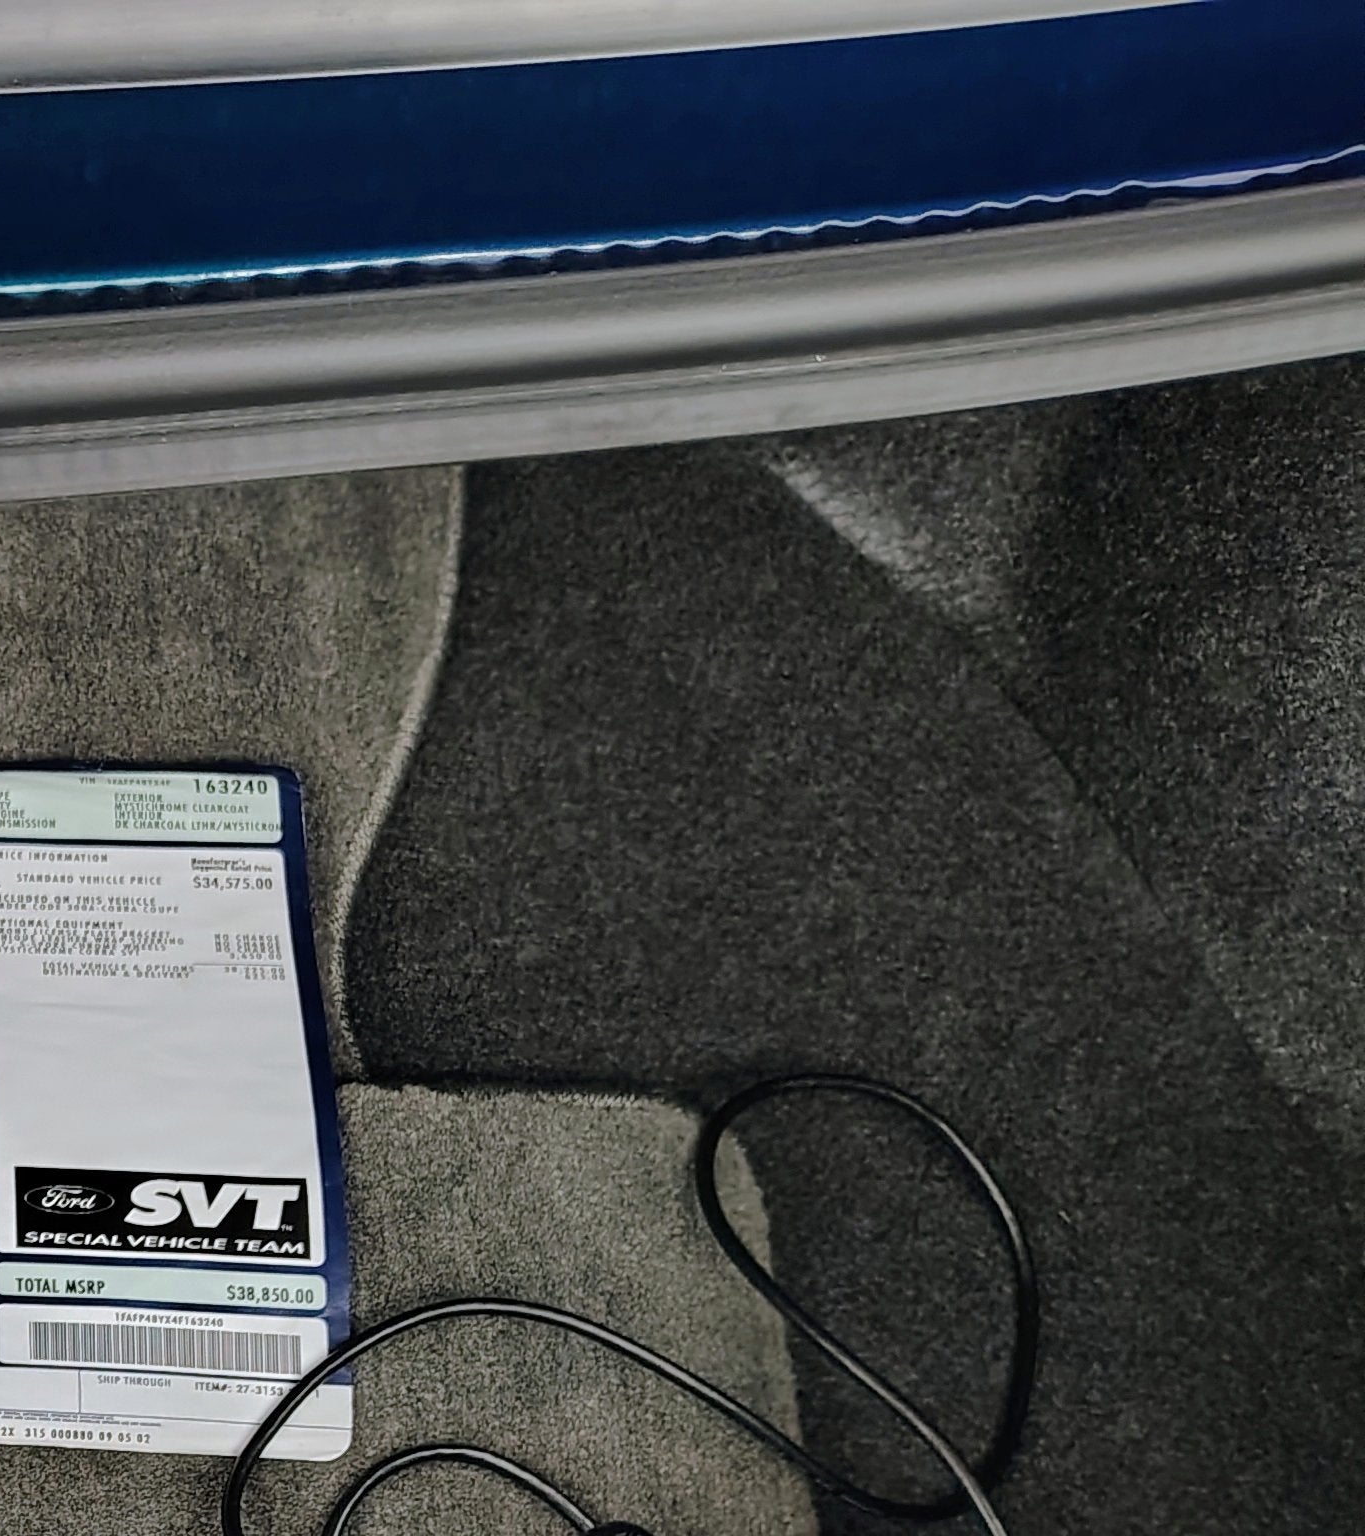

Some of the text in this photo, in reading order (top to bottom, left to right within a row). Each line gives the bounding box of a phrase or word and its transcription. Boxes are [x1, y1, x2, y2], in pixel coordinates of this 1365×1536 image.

[192, 778, 267, 795] 163240
[16, 873, 161, 887] STANDARD VEHICLE PRICE
[193, 877, 272, 891] $34,575.00
[41, 1185, 96, 1210] Ford
[124, 1179, 300, 1230] SVT
[24, 1231, 304, 1255] SPECIAL VEHICLE TEAM
[16, 1278, 314, 1305] TOTAL MSRP $38,850.00
